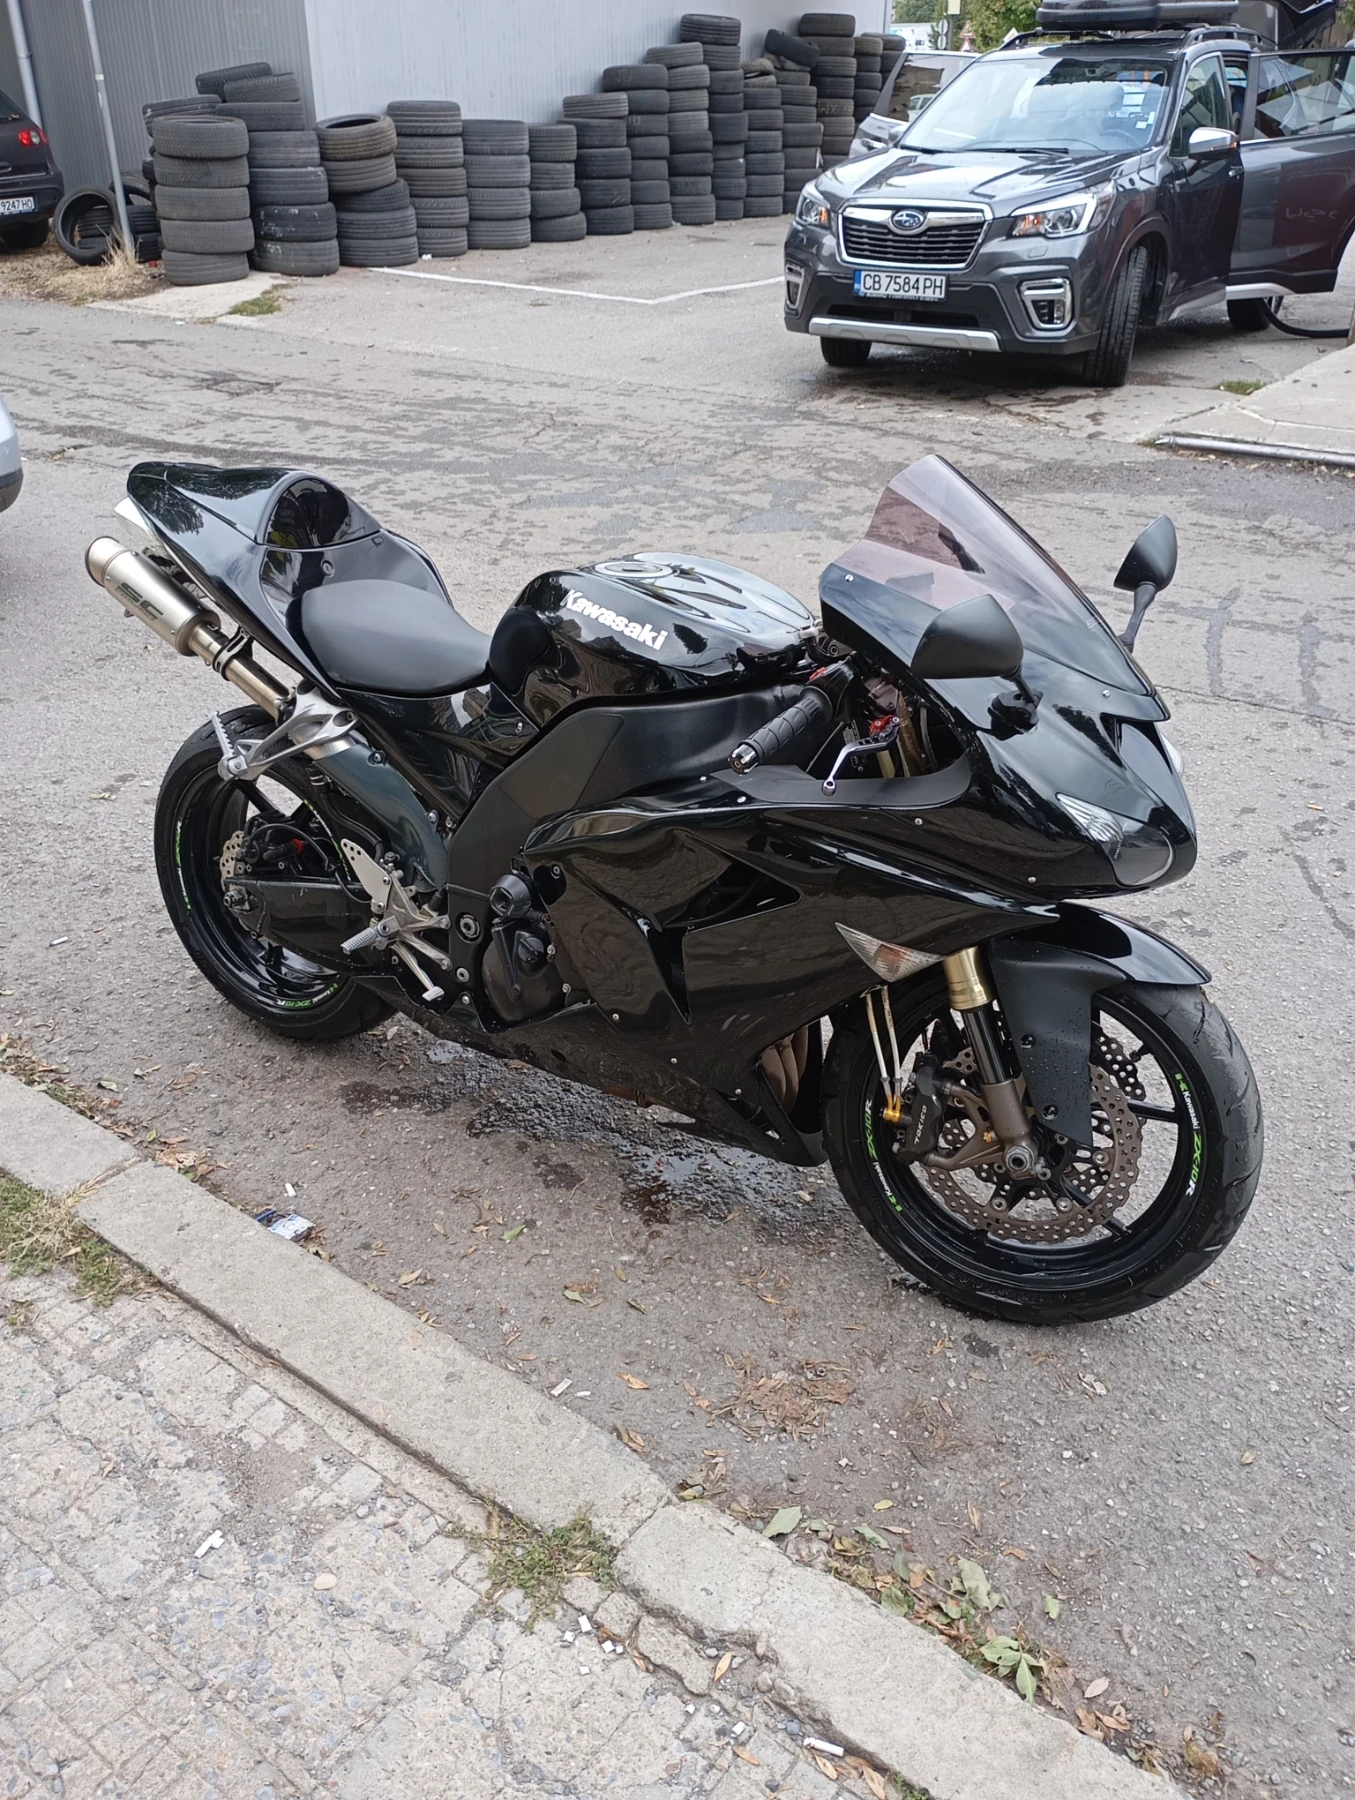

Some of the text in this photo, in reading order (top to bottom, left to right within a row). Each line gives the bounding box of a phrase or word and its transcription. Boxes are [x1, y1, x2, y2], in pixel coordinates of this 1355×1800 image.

[1, 200, 20, 211] 9247
[863, 273, 882, 291] CB
[884, 275, 920, 294] 7584
[922, 277, 944, 296] PH
[560, 589, 669, 651] Kawasaki
[865, 1099, 878, 1160] ZX-10R
[914, 1105, 928, 1145] TOKICO
[1182, 1091, 1202, 1197] Kawasaki ZX-10R
